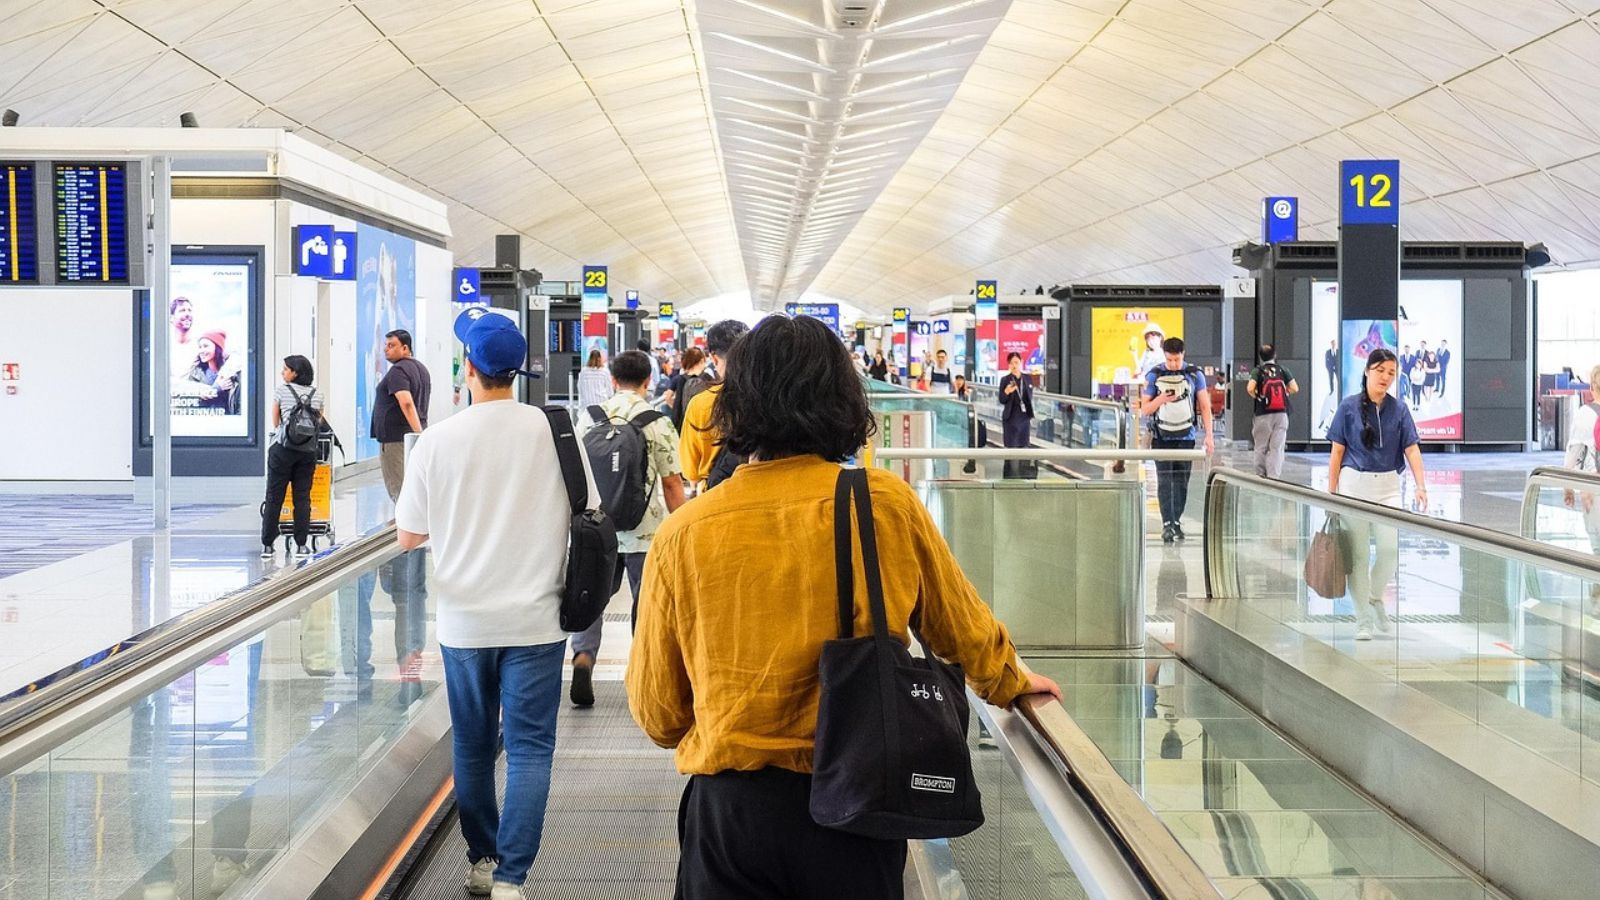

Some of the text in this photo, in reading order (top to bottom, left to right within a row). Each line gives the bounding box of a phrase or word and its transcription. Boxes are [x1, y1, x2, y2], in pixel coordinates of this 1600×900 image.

[1350, 174, 1391, 207] 12
[585, 271, 606, 287] 23
[978, 285, 995, 298] 24
[188, 408, 225, 416] FINNAIR
[914, 777, 952, 789] BROMPTON
